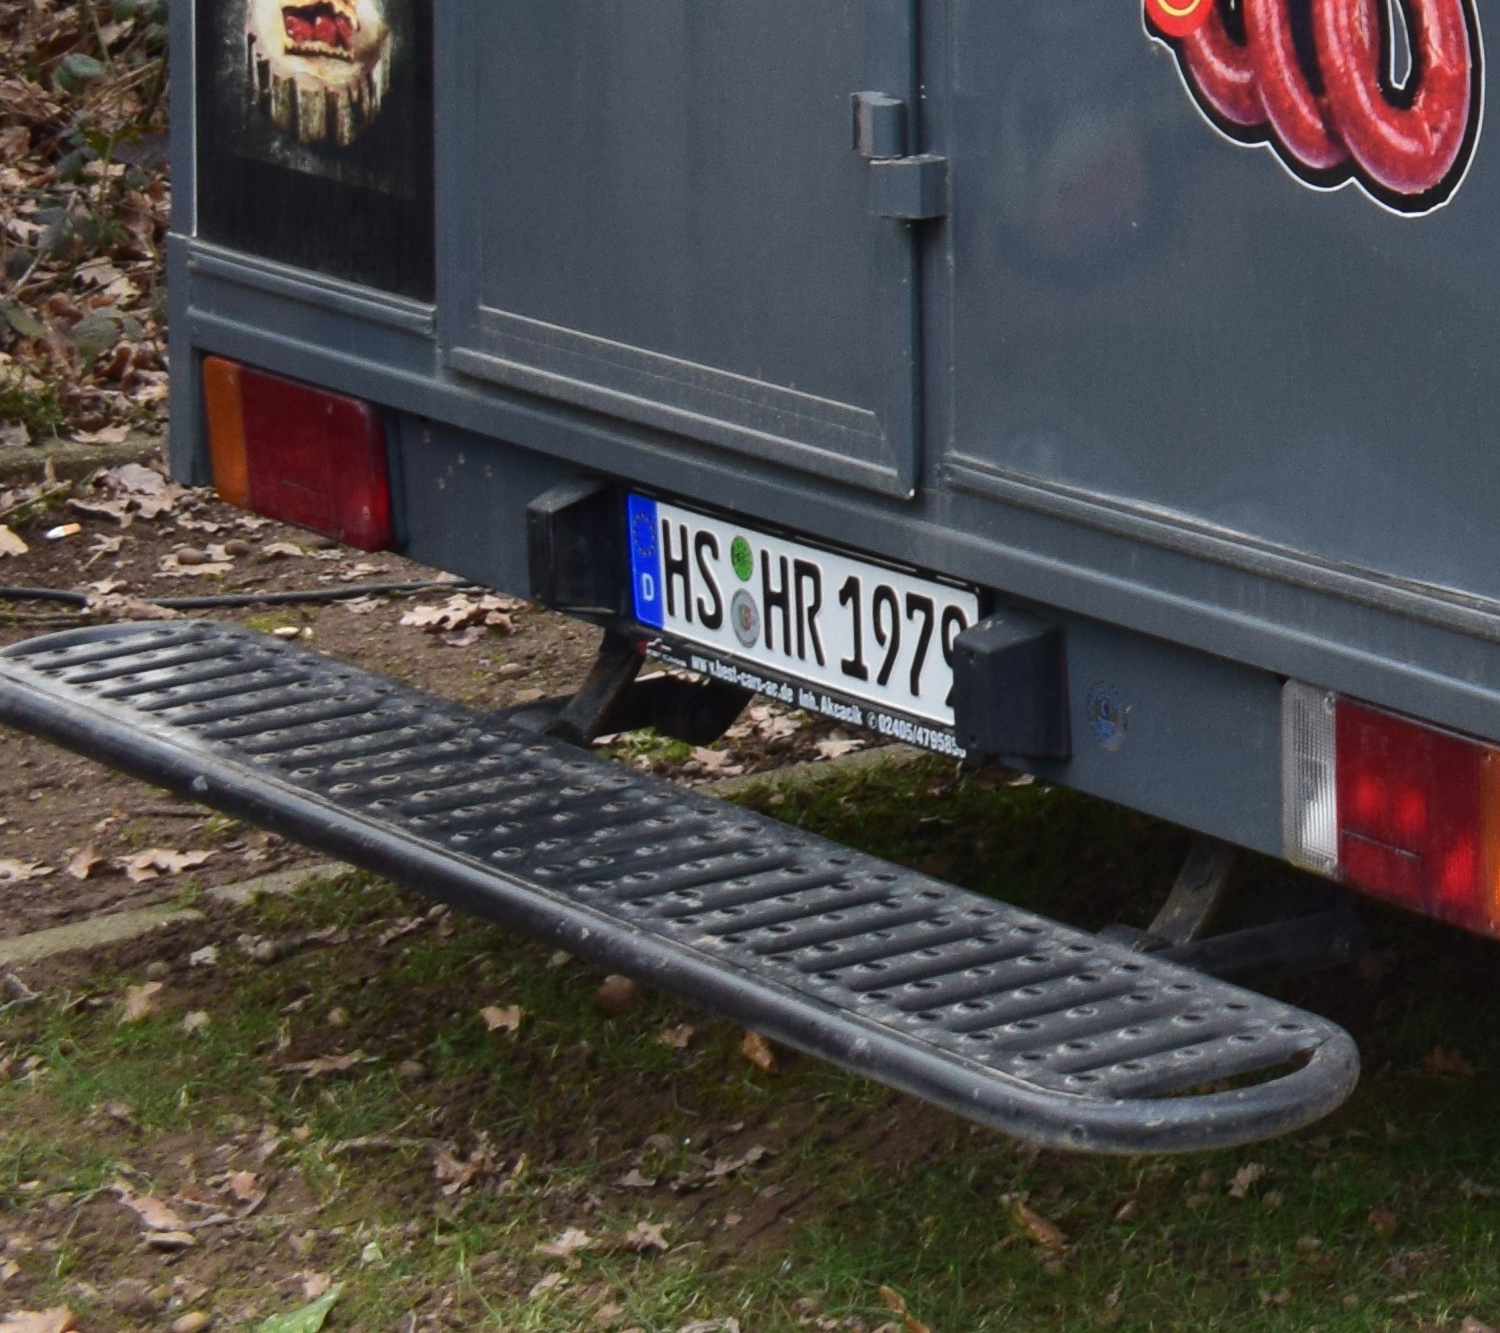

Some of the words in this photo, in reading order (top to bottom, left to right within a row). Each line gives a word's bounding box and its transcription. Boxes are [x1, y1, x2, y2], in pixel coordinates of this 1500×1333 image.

[641, 572, 654, 603] D
[661, 517, 724, 630] HS
[760, 548, 827, 668] HR
[691, 654, 794, 703] www.best-cars-ac.de
